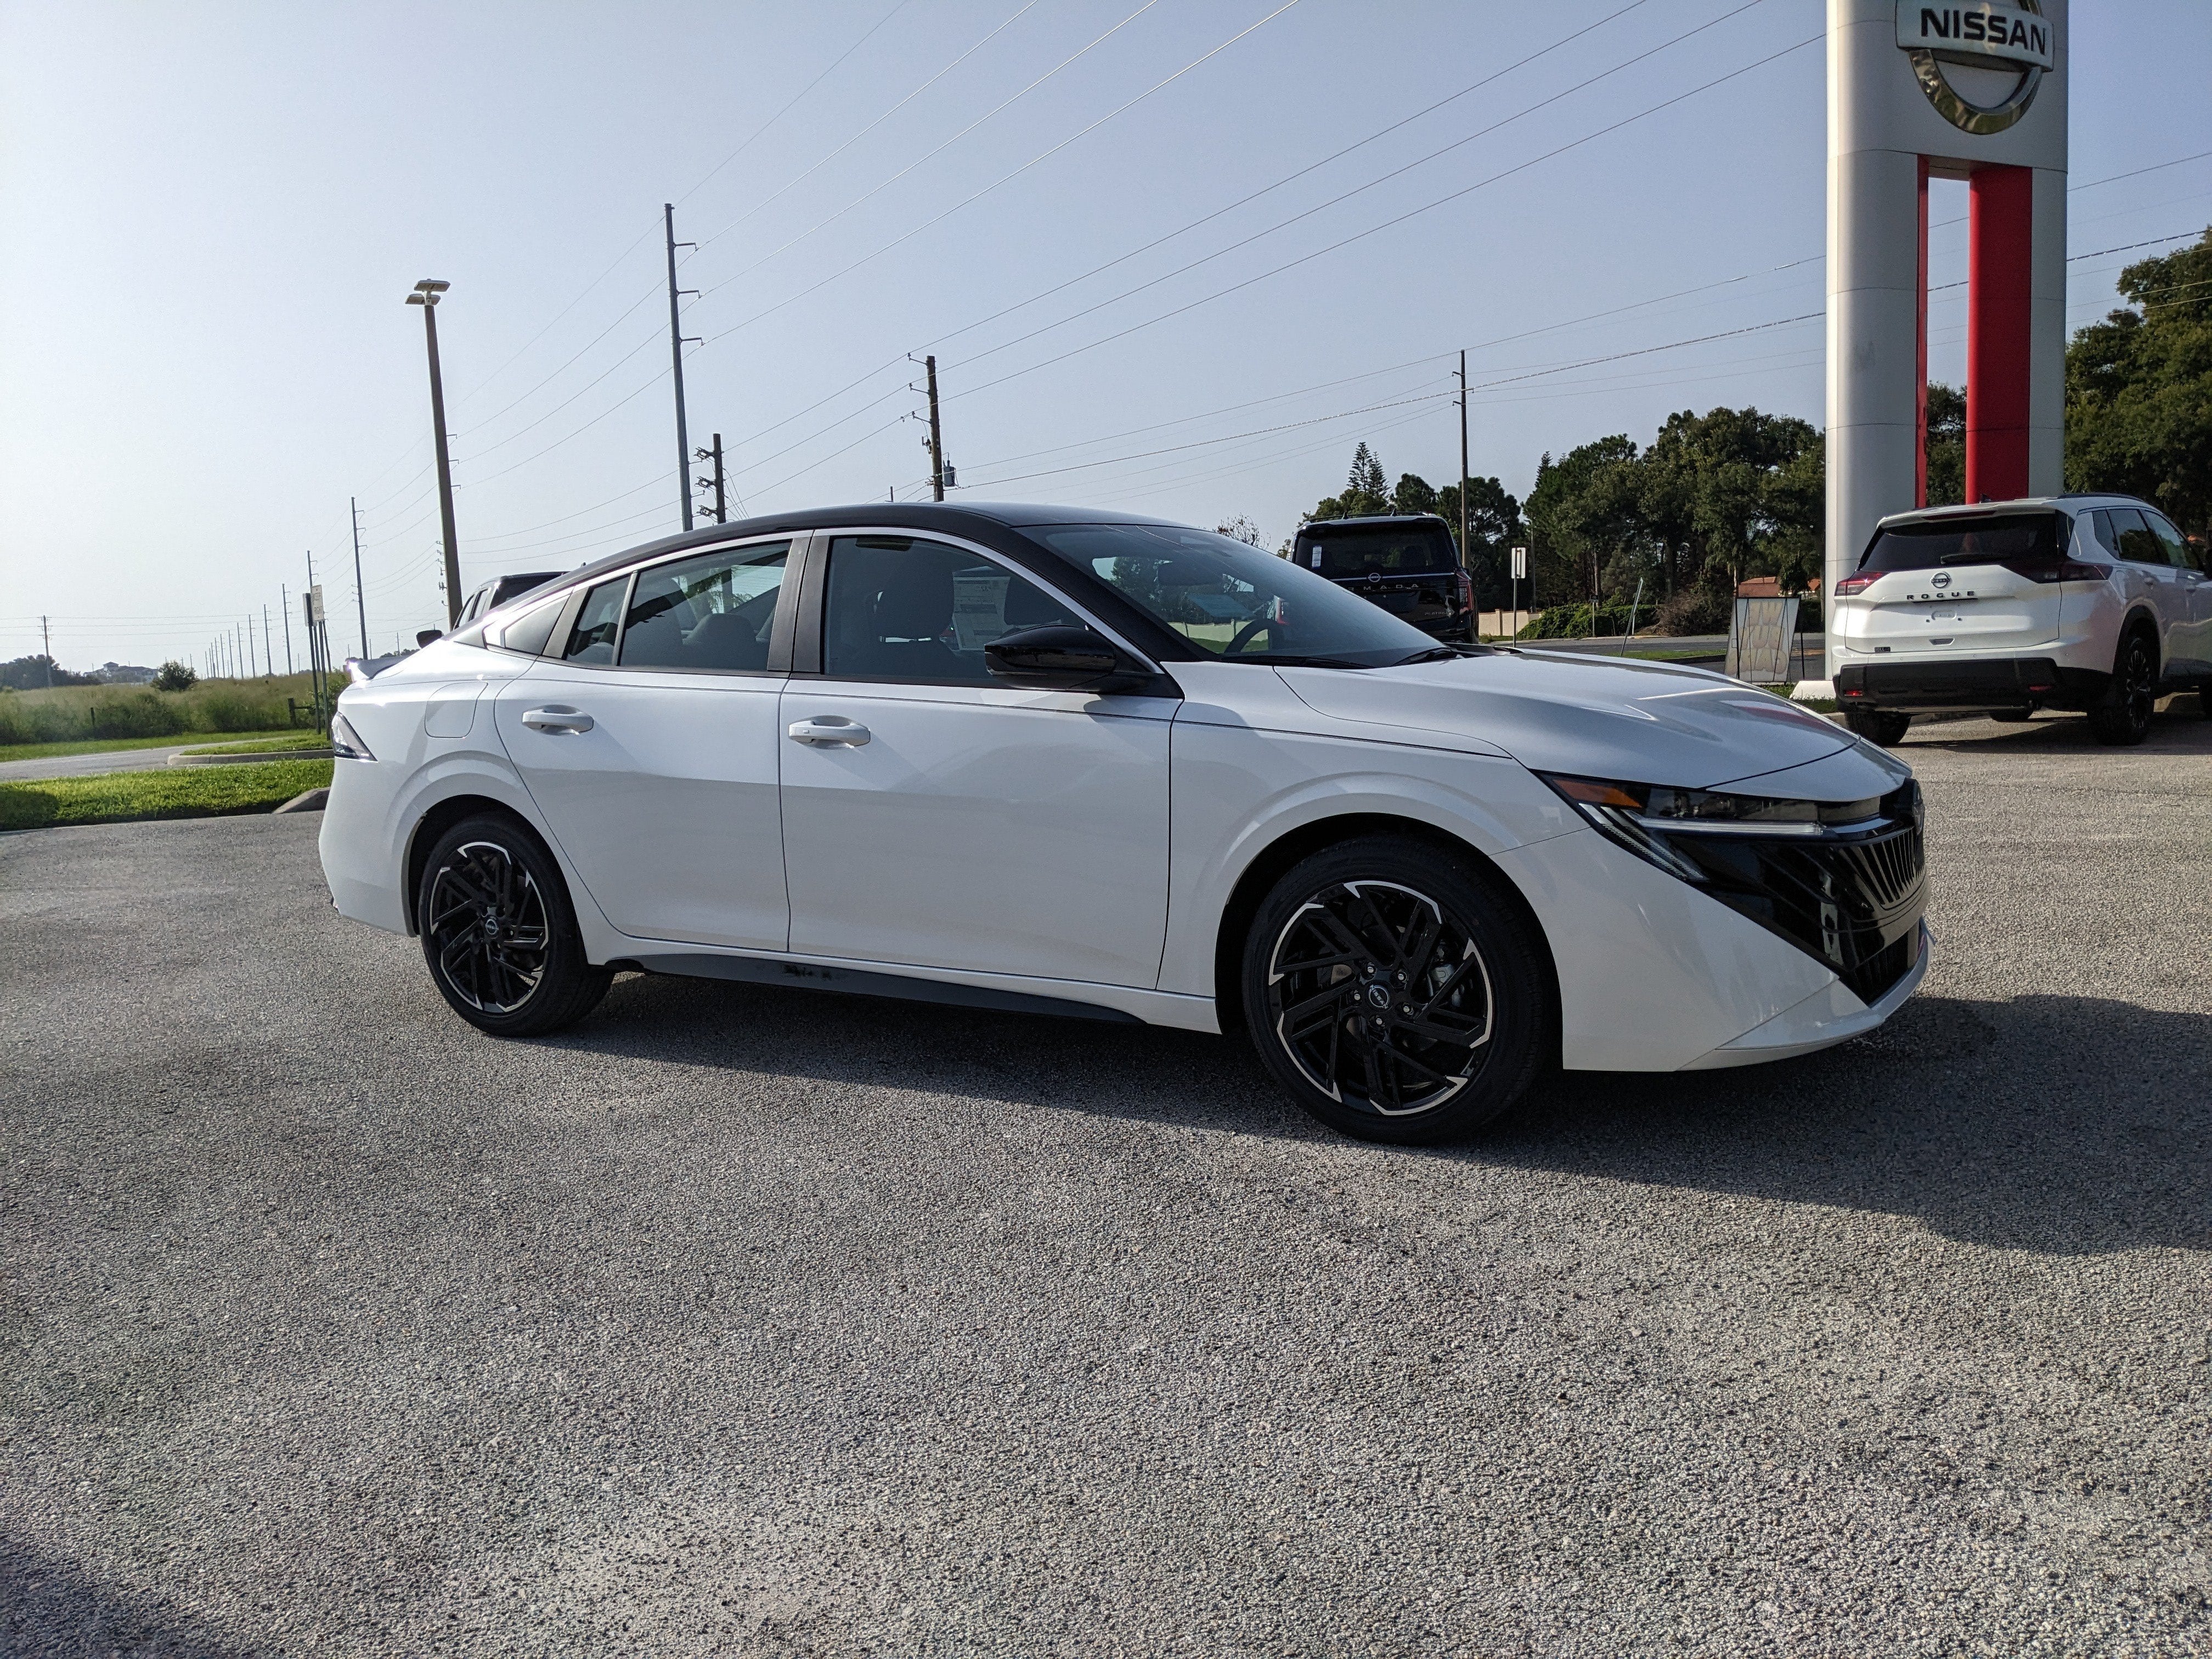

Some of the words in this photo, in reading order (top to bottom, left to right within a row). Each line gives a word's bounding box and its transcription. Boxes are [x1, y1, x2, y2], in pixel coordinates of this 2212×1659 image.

[1921, 8, 2046, 56] NISSAN
[1906, 591, 1975, 600] ROGUE
[1369, 984, 1389, 1009] NISSAN
